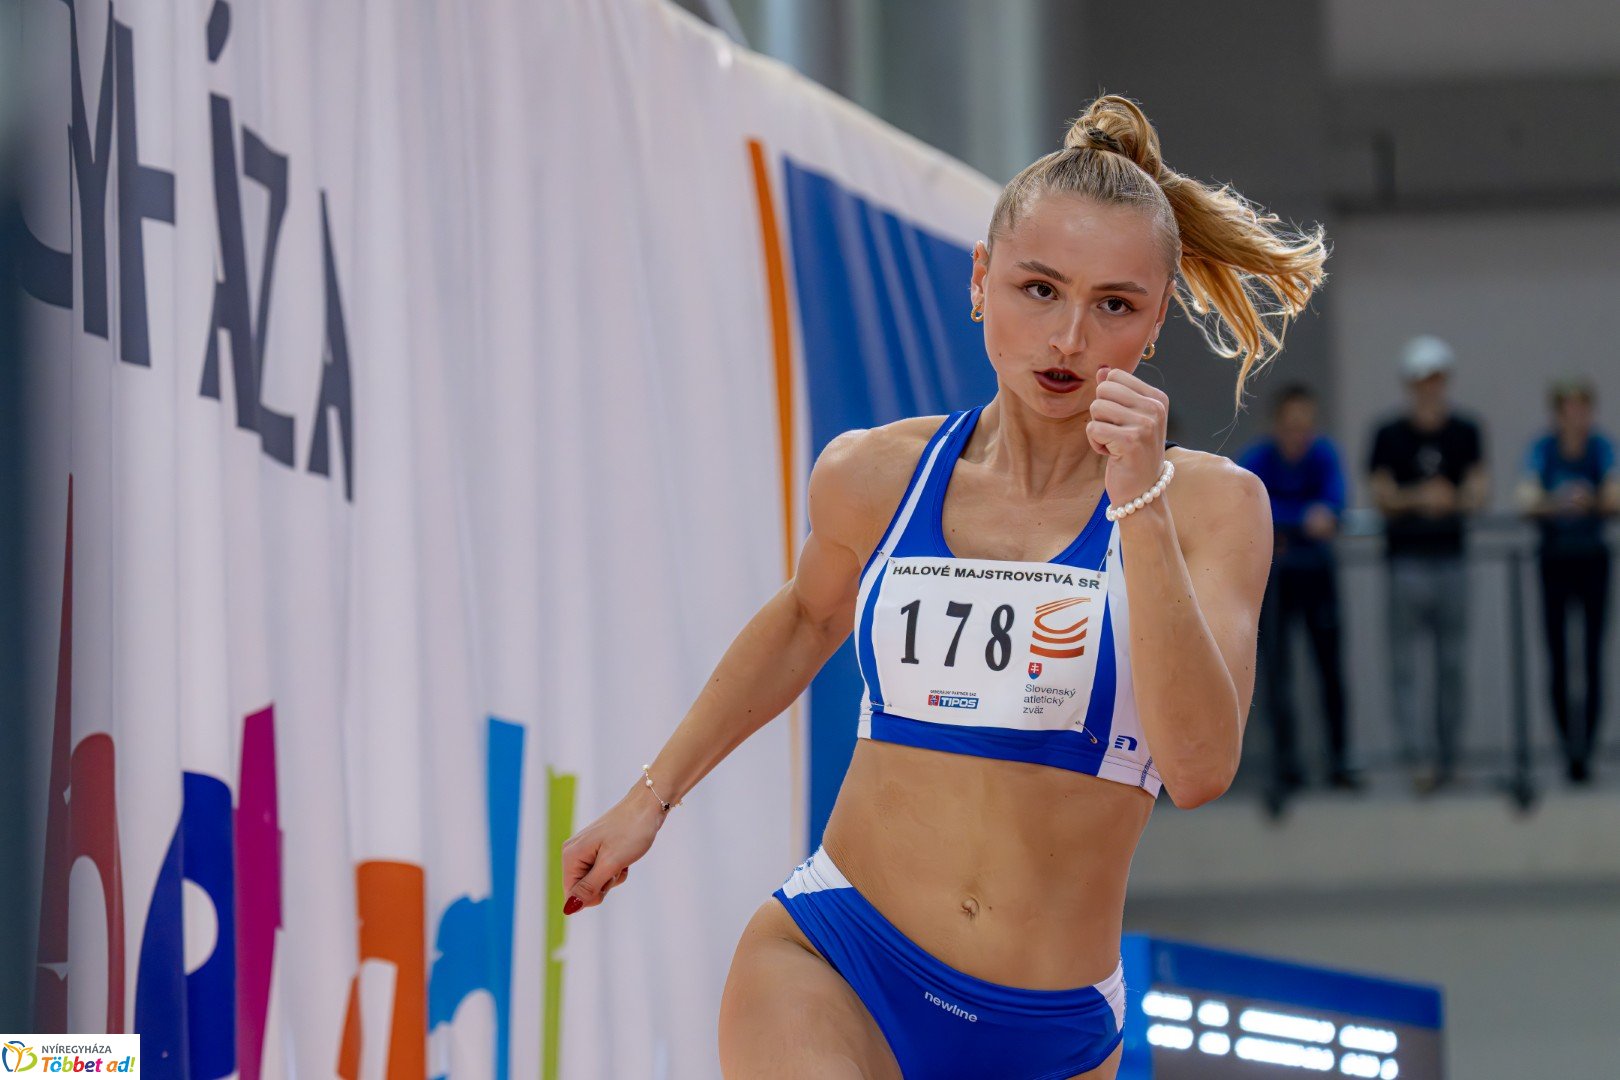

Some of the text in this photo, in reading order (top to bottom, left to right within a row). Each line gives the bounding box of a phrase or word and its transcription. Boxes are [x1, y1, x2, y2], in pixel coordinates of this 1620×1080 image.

[892, 564, 1100, 590] HALOVÉ MAJSTROVSTVÁ SR
[900, 598, 1016, 672] 178
[1024, 683, 1077, 699] Slovenský
[940, 696, 978, 709] TIPOS
[1023, 694, 1065, 707] atletický
[1022, 704, 1044, 715] zväz
[924, 991, 978, 1023] newline
